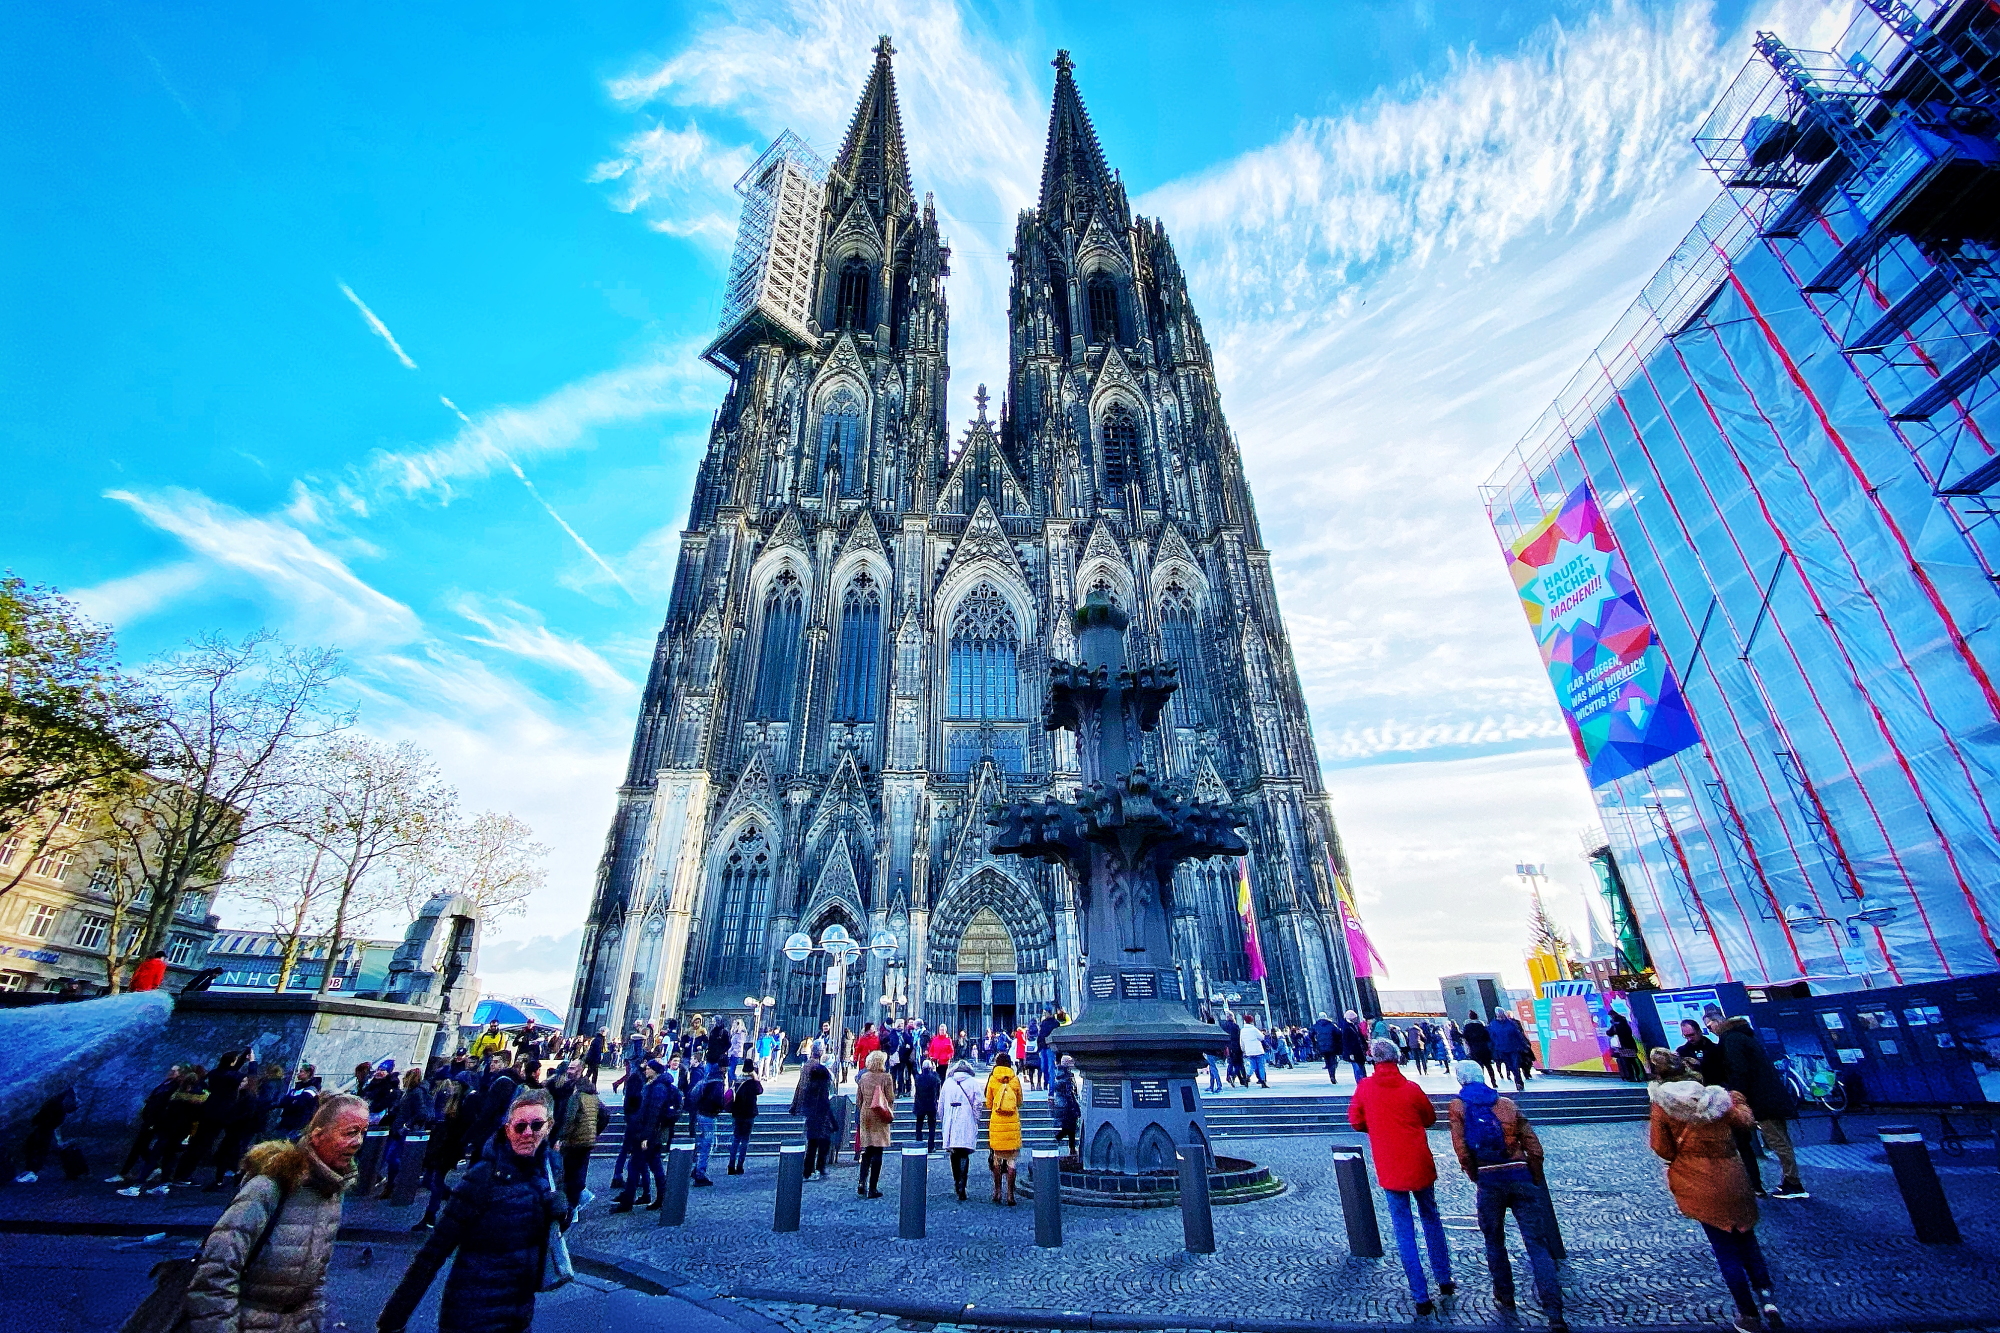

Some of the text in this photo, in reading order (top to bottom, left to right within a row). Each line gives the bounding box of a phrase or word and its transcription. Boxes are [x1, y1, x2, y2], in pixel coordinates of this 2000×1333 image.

[1543, 554, 1590, 591] HAUPT-
[1547, 563, 1597, 604] SACHEN
[1550, 574, 1602, 621] MACHEN!!!
[1566, 654, 1623, 695] KLAR KRIEGEN,
[1571, 656, 1646, 708] WAS MIR WIRKLICH
[1575, 687, 1621, 722] WICHTIG IST
[212, 970, 301, 988] NHOF
